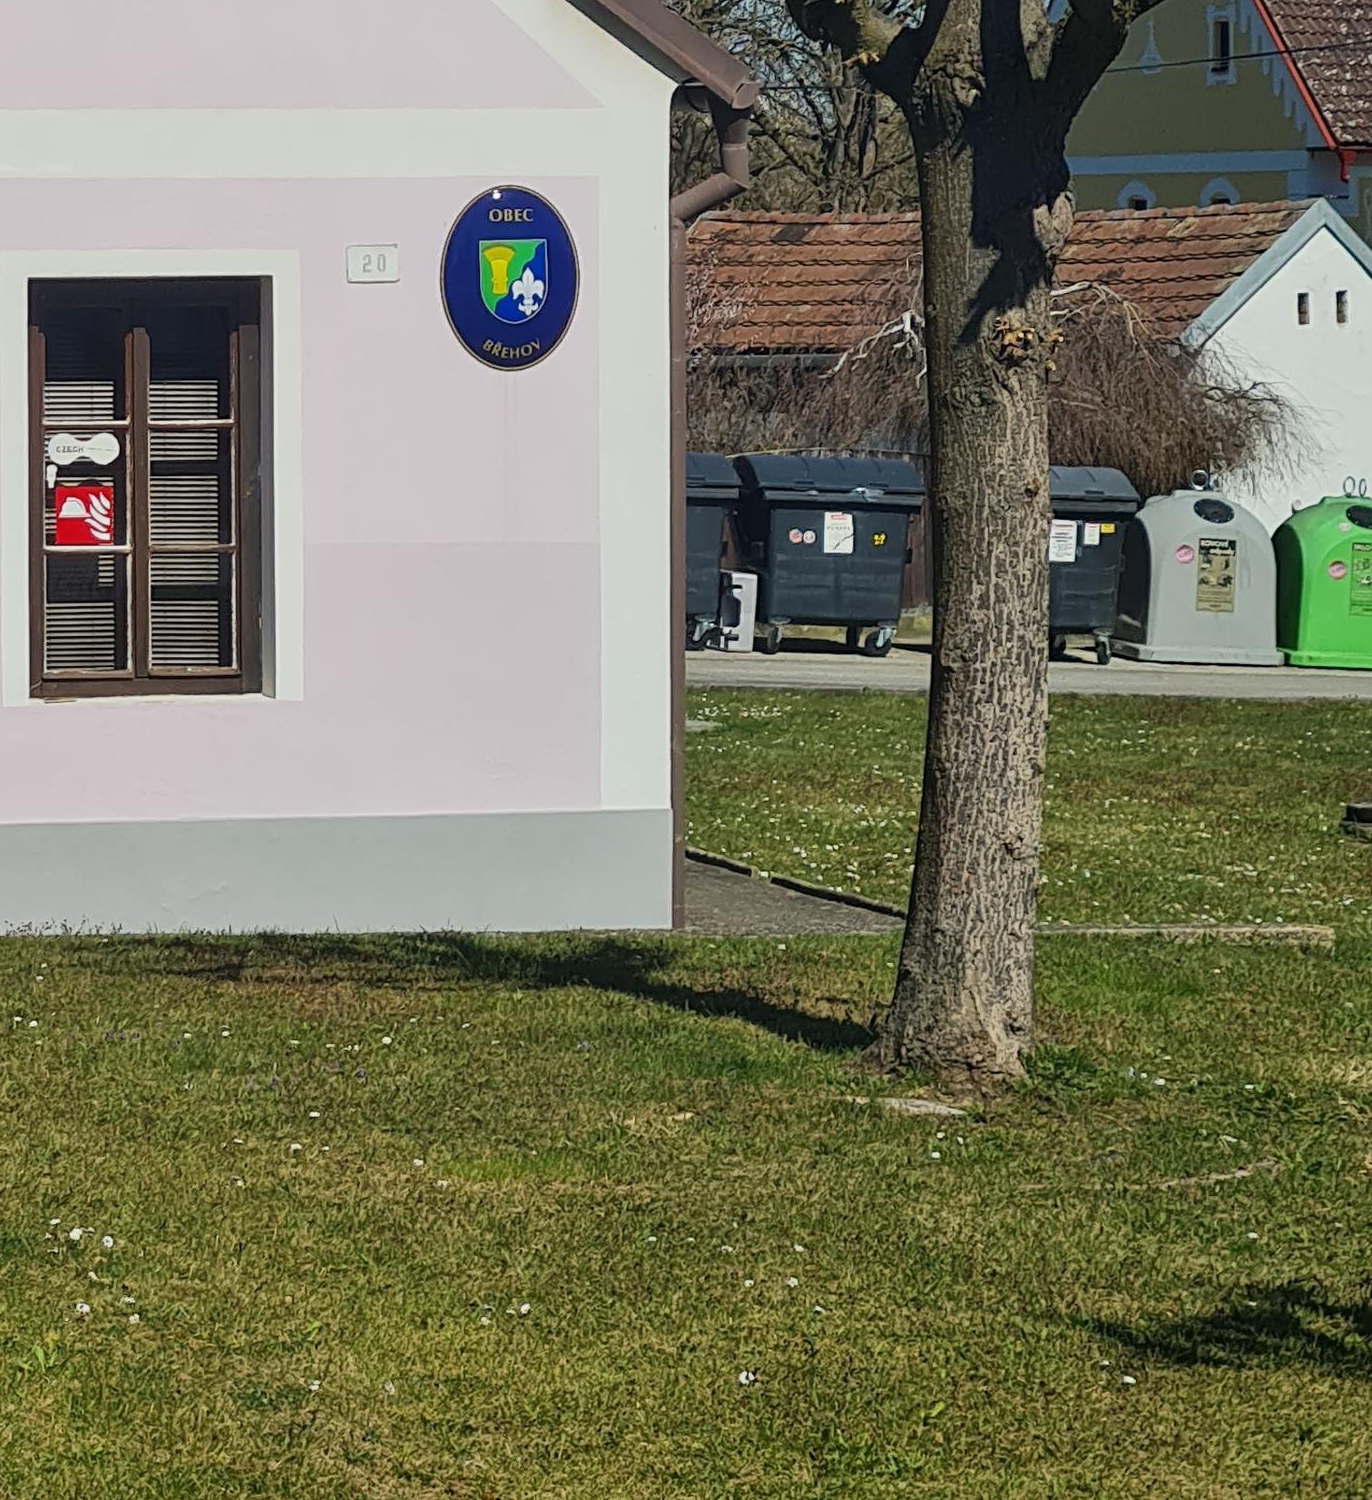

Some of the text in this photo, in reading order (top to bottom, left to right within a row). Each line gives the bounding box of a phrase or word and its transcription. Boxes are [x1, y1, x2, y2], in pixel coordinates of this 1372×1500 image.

[488, 208, 535, 222] OBEC
[361, 253, 387, 274] 20
[482, 338, 541, 360] BŘEHOV
